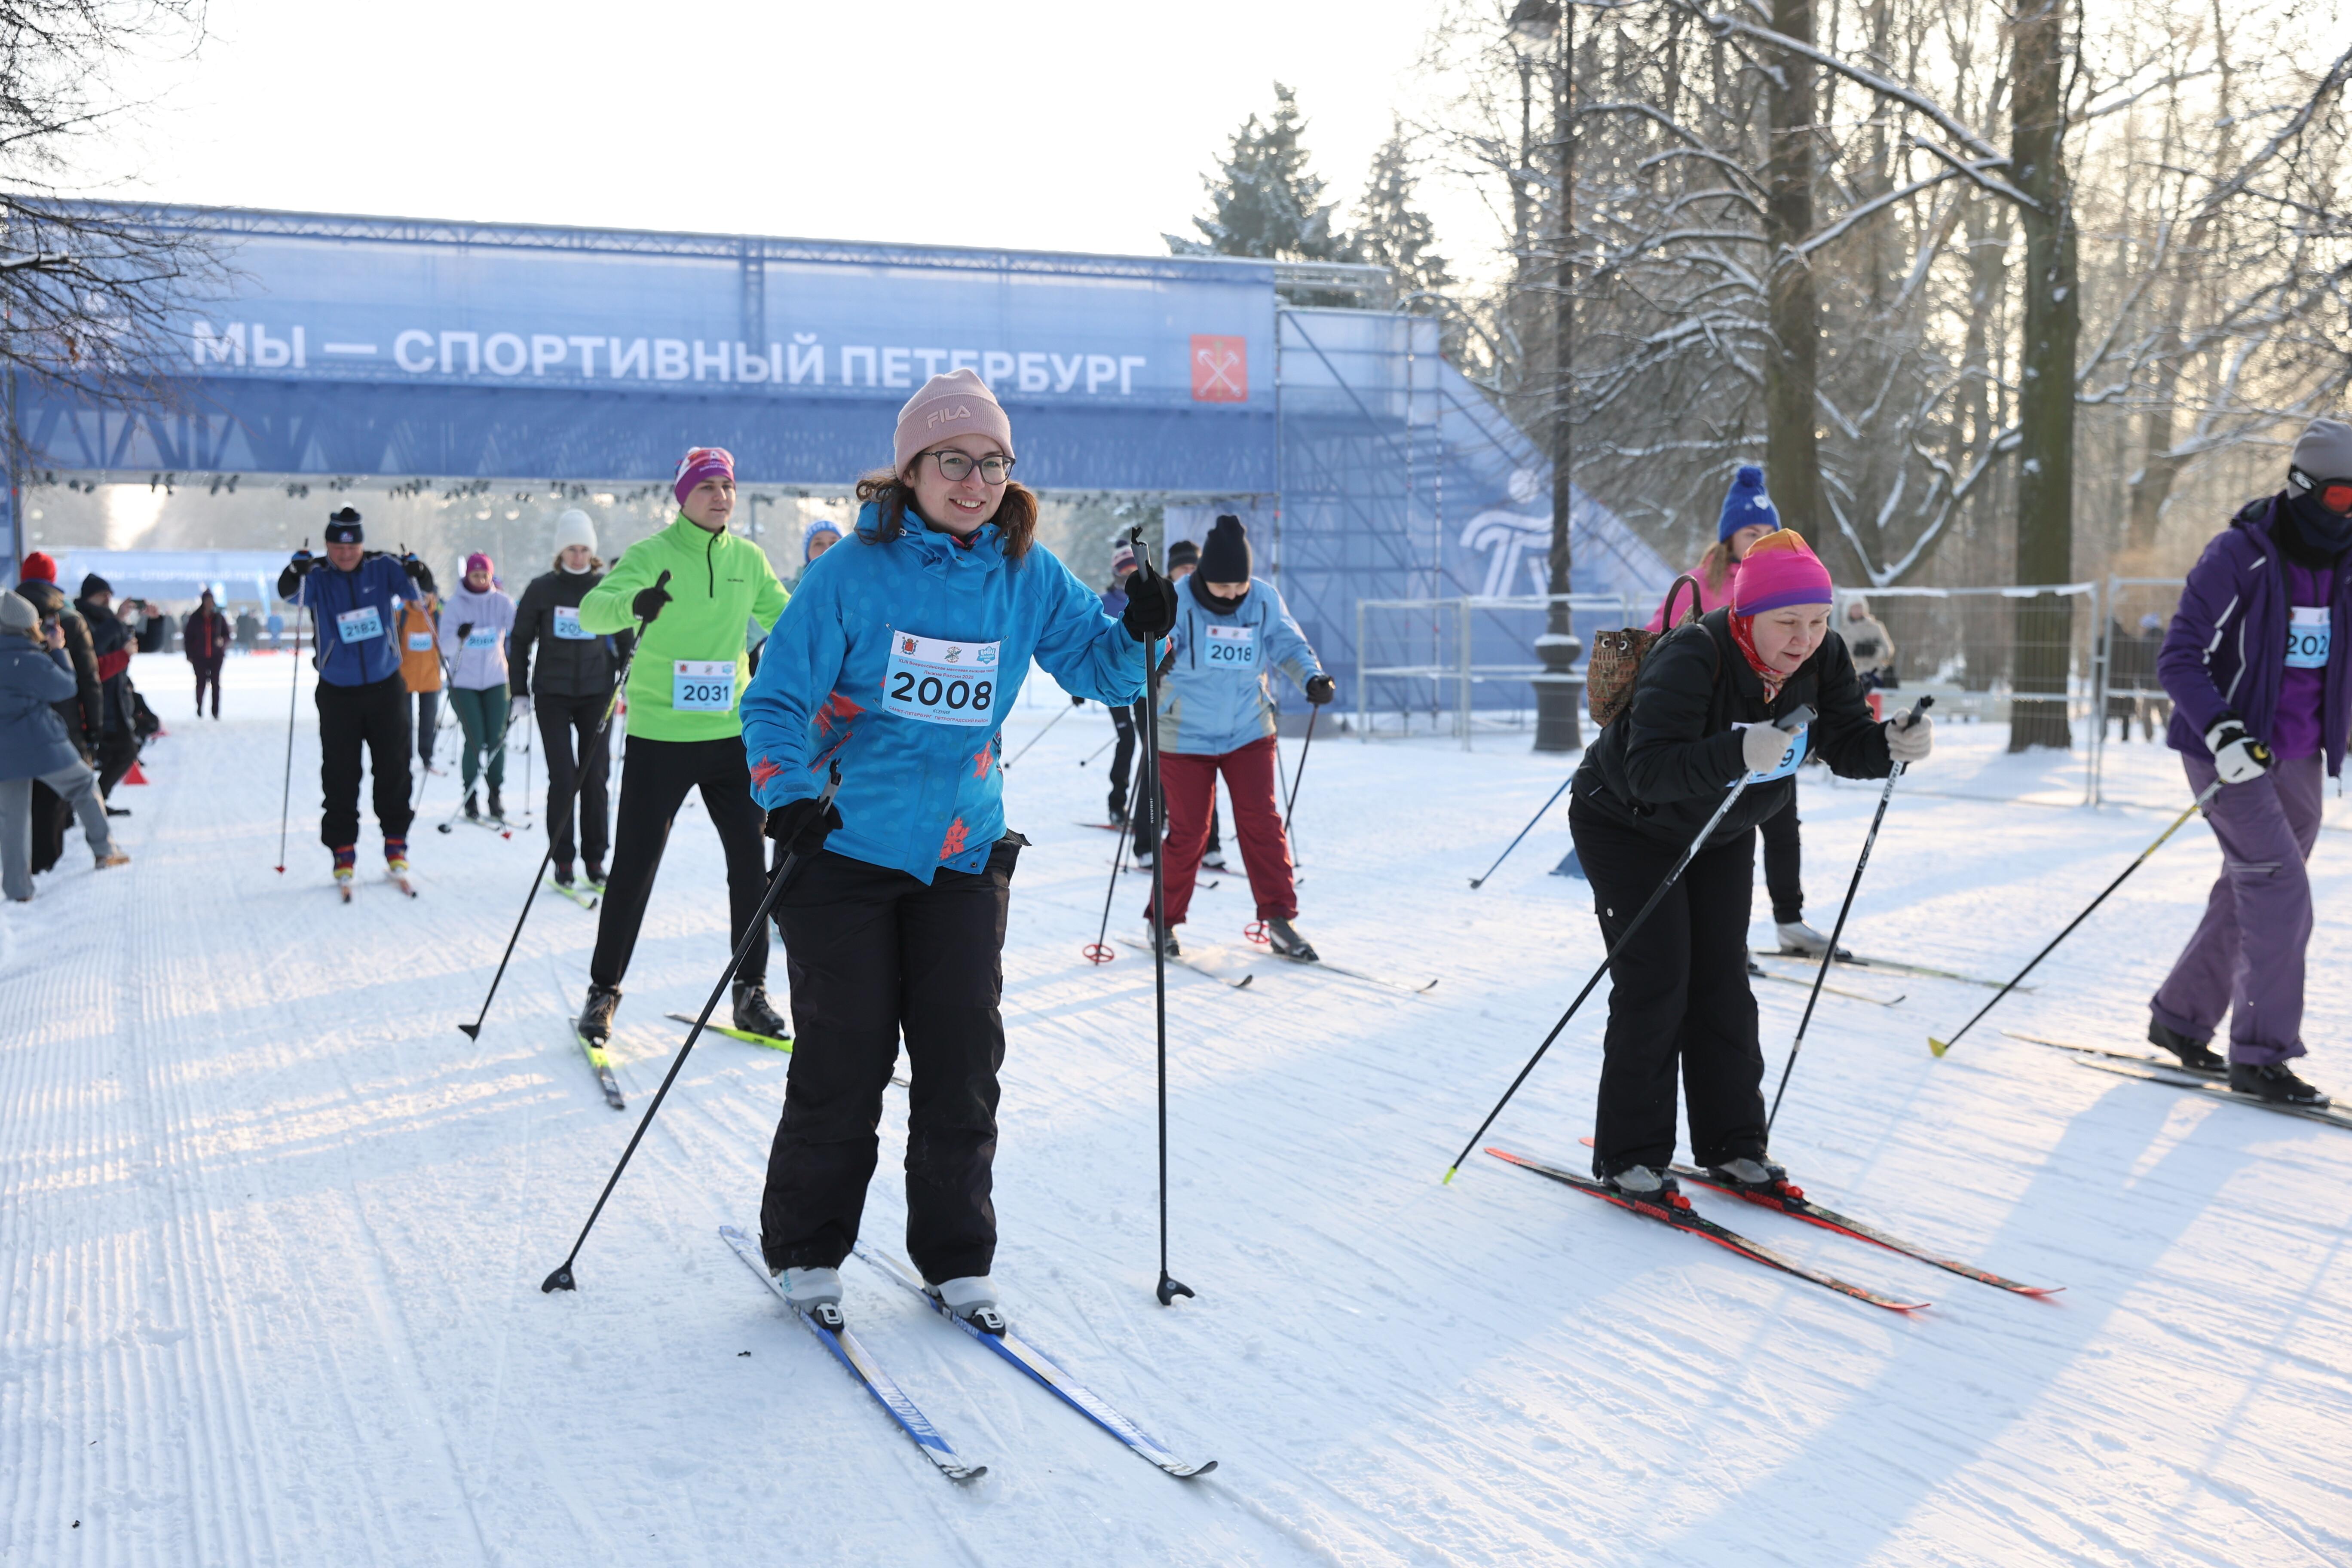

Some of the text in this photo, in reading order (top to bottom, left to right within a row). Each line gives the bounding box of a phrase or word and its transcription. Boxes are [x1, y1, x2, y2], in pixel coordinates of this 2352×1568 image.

[192, 321, 306, 368] МЫ
[393, 328, 824, 386] СПОРТИВНЫЙ
[841, 346, 1146, 395] ПЕТЕРБУРГ
[927, 405, 970, 429] FILA
[346, 621, 378, 637] 2182
[1211, 645, 1251, 661] 2018
[2287, 635, 2328, 655] 202
[684, 685, 729, 701] 2031
[891, 672, 992, 710] 2008
[889, 706, 932, 718] САНКТ-ПЕТЕРБУРГ
[1884, 763, 1899, 799] NORDWAY
[877, 1387, 940, 1437] NORDWAY
